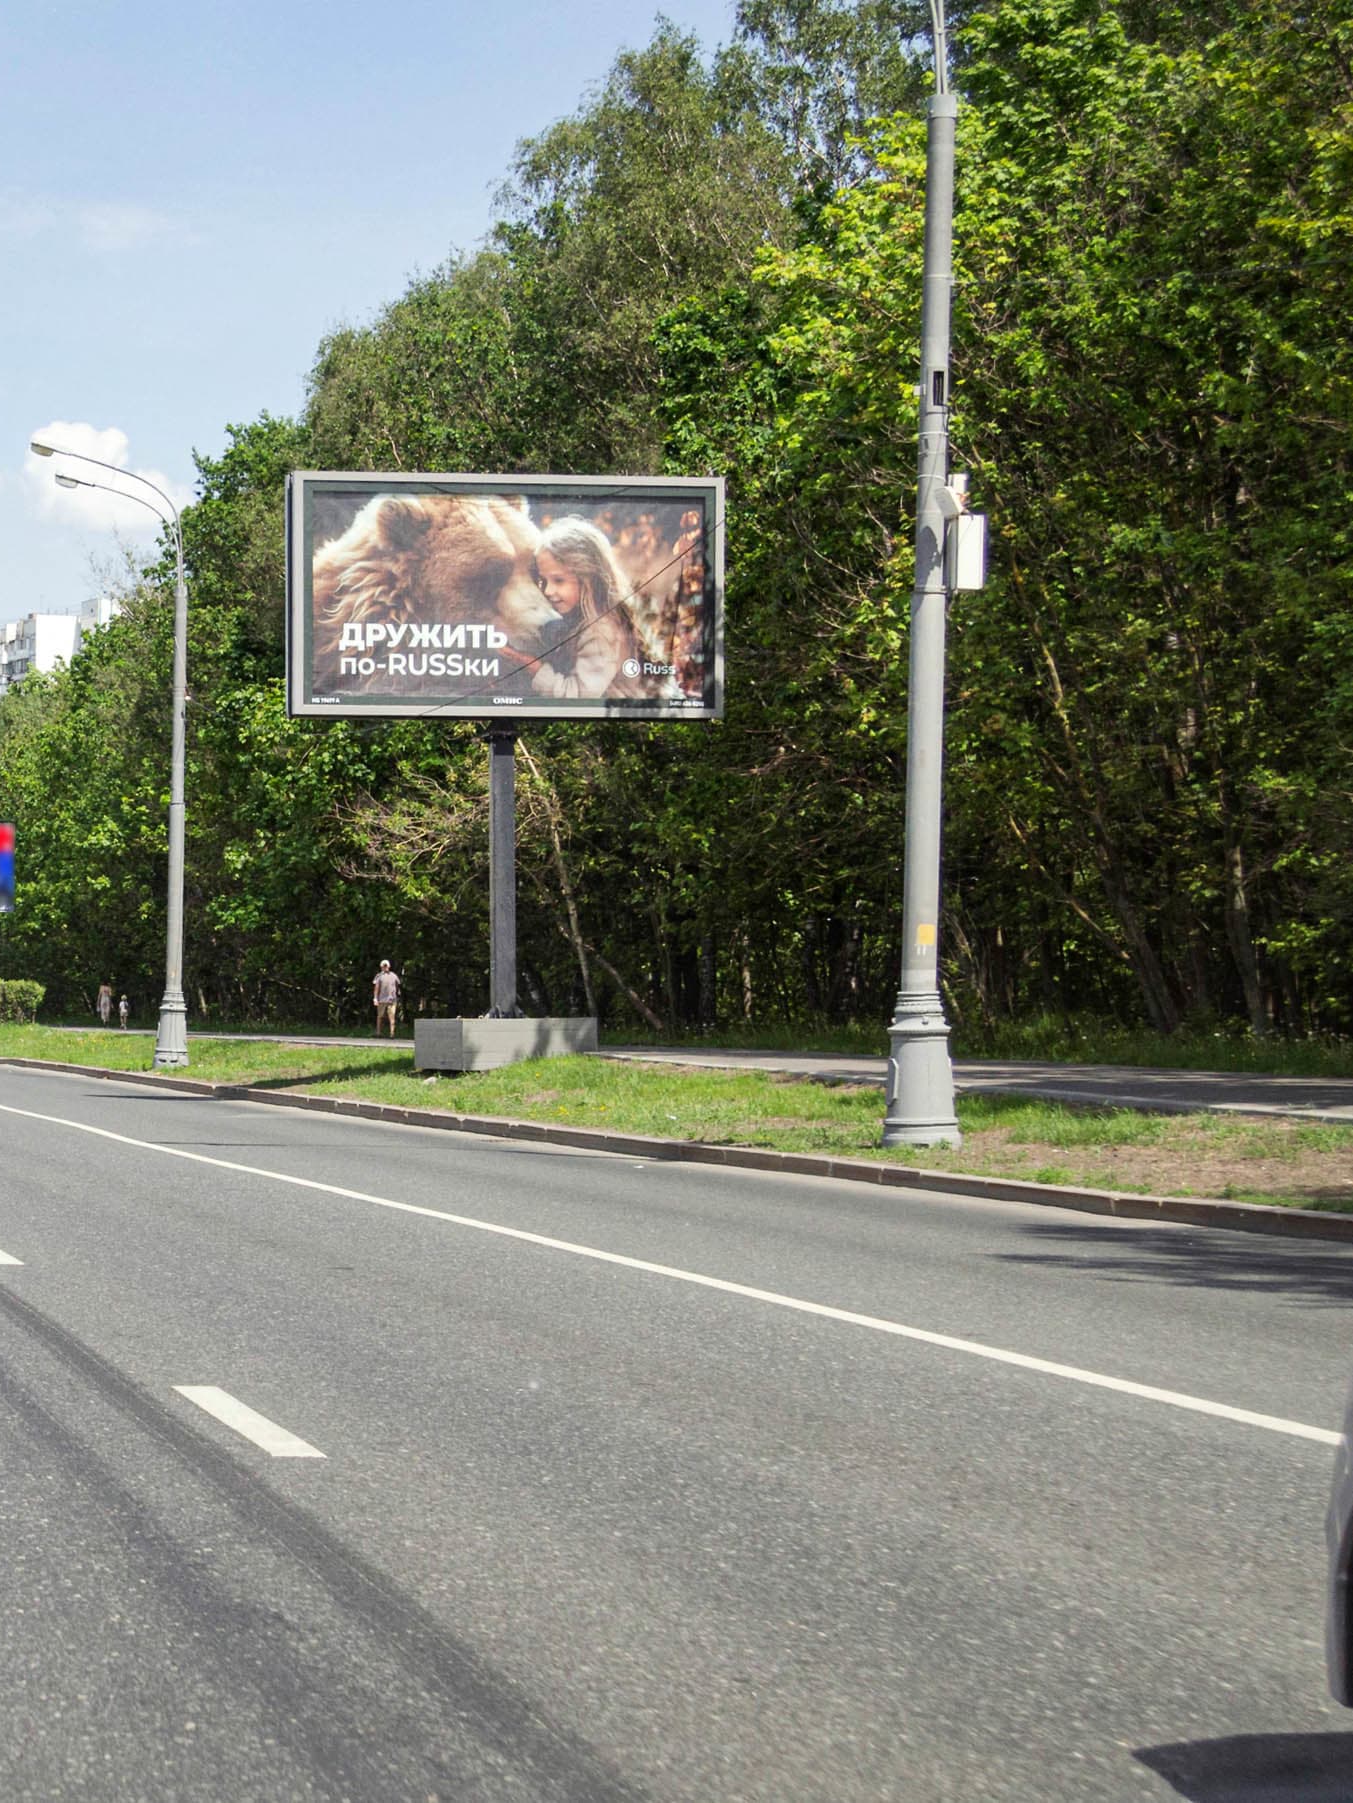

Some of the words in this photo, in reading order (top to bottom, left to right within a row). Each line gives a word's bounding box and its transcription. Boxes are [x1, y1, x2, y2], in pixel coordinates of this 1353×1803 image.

[339, 622, 508, 651] ДРУЖИТЬ
[340, 652, 500, 677] по-RUSSки
[643, 662, 677, 676] Russ
